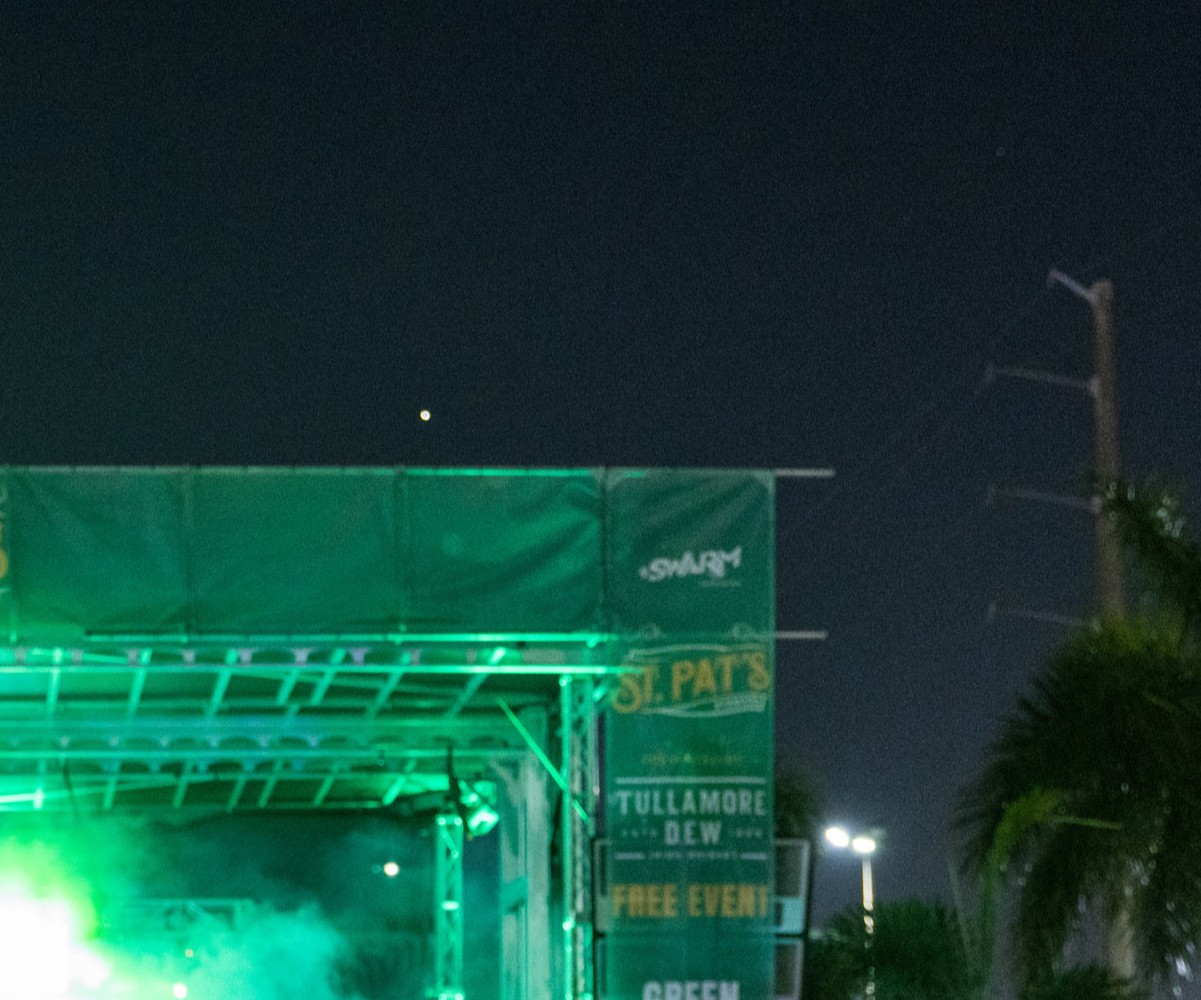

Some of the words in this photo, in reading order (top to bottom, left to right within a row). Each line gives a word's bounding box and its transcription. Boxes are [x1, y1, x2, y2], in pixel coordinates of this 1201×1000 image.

[617, 789, 767, 816] TULLAMORE
[664, 820, 722, 845] DEW
[612, 884, 677, 917] FREE
[688, 884, 768, 917] EVENT
